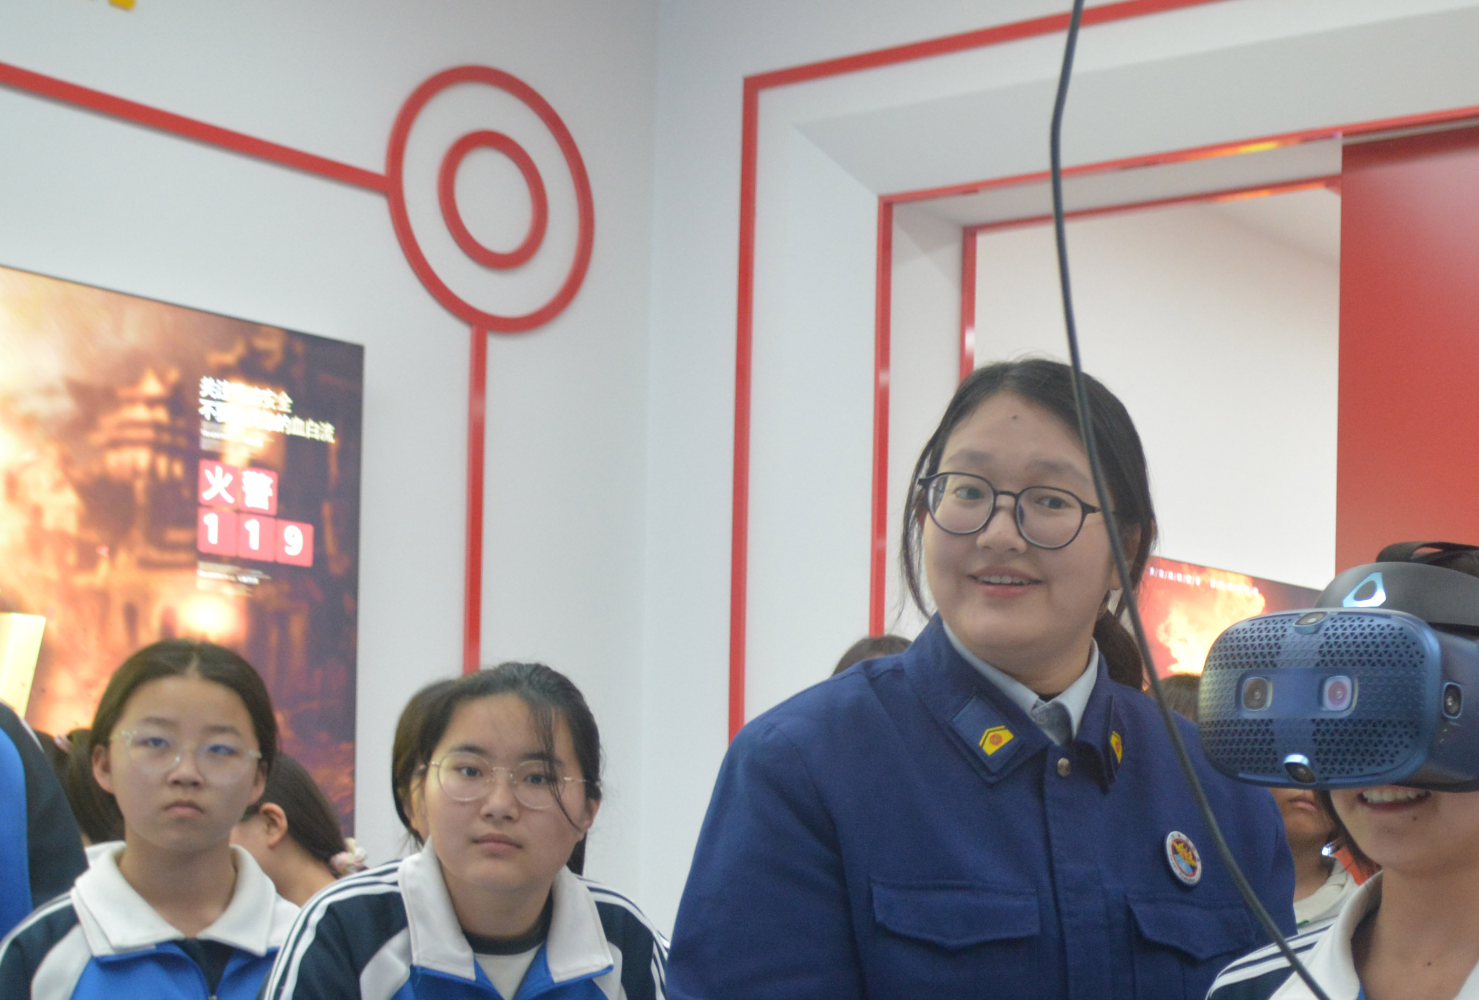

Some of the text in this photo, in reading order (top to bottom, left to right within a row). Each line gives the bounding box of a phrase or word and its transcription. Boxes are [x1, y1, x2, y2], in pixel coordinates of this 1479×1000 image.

[199, 376, 293, 413] 关注安全
[202, 465, 273, 510] 火警
[203, 512, 304, 556] 119
